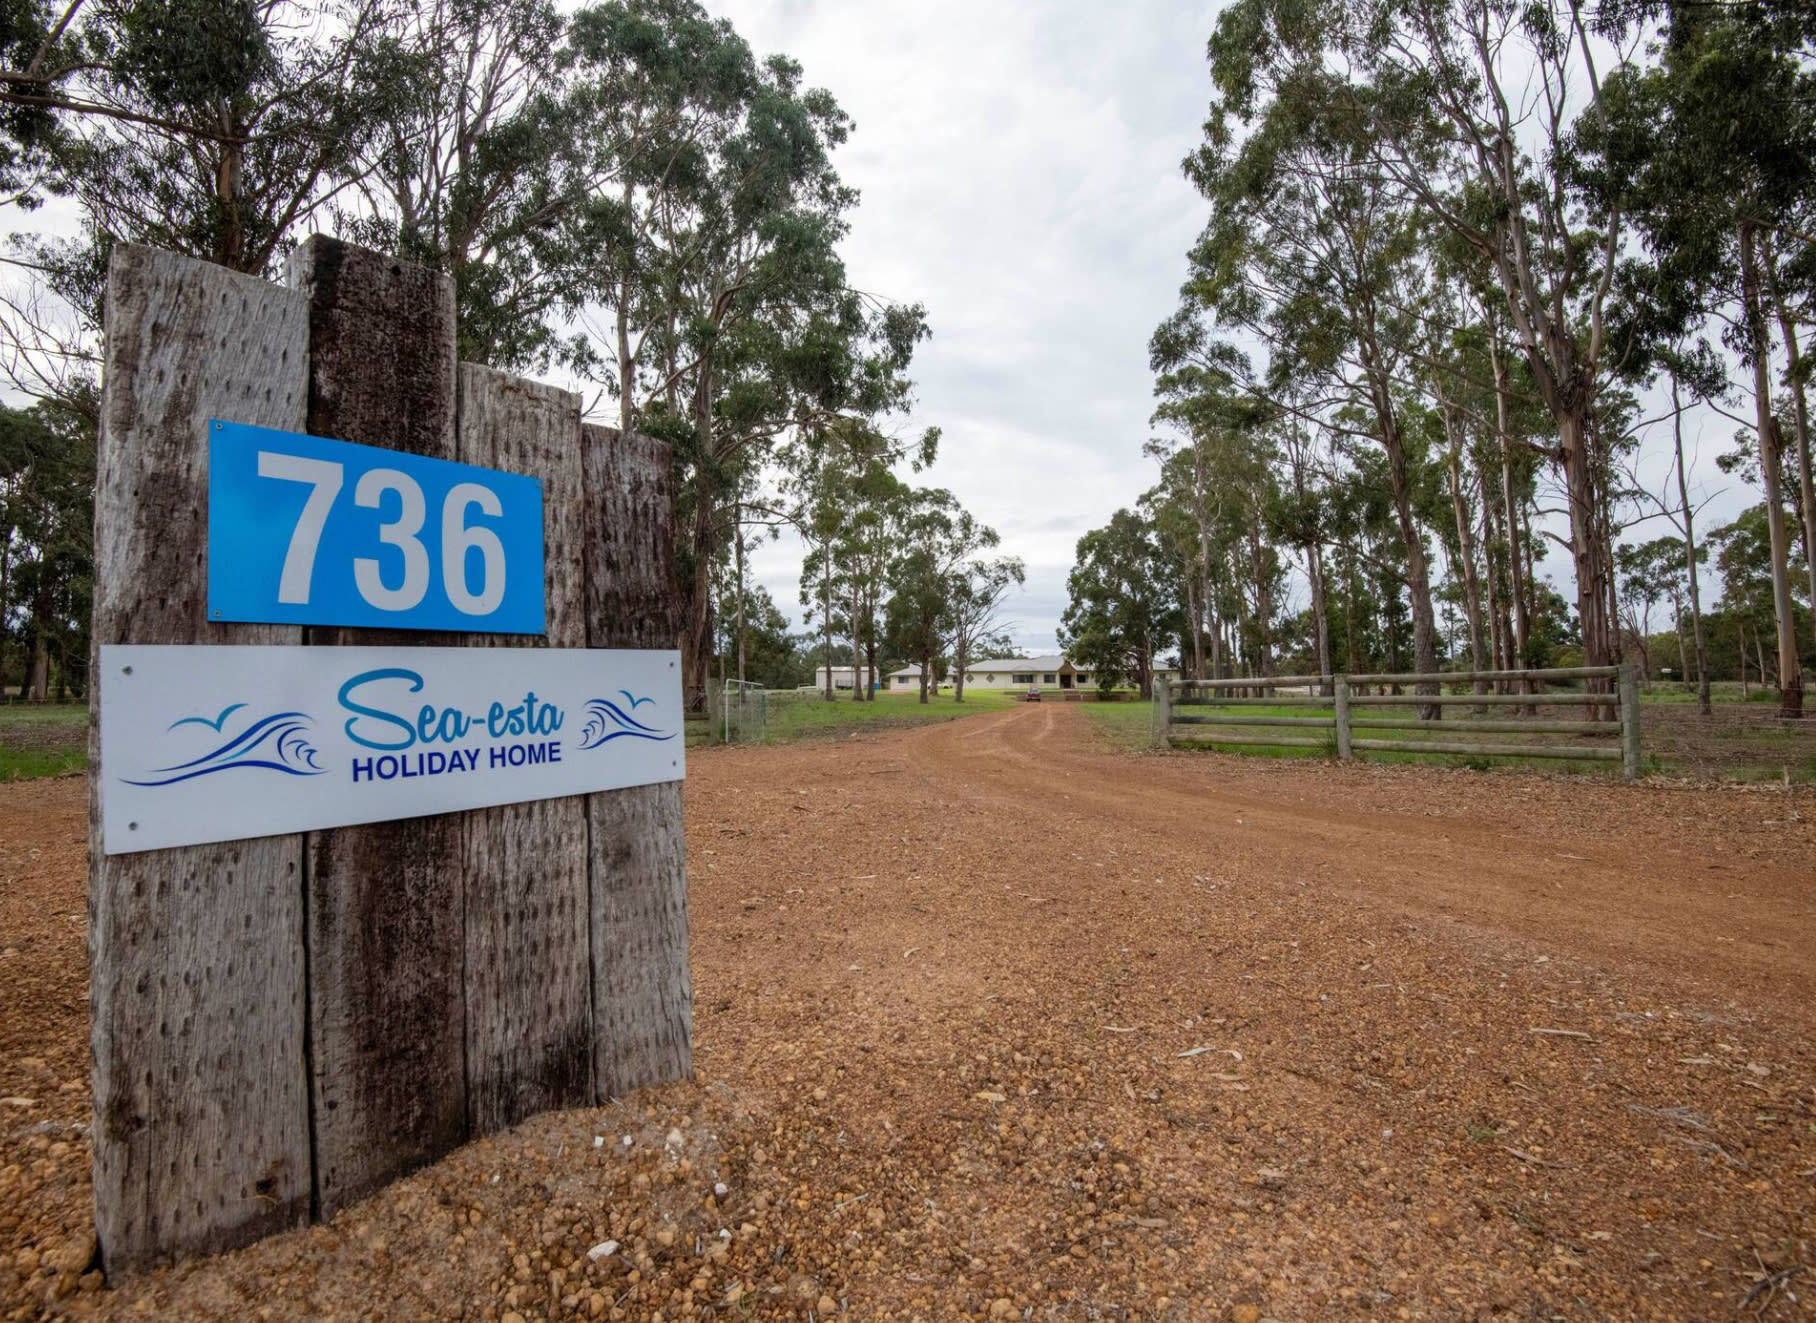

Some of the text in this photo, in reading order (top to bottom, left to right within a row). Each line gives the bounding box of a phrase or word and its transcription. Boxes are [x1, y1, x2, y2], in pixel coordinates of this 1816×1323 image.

[257, 450, 507, 616] 736
[337, 667, 565, 751] Sea-esta
[352, 741, 562, 782] HOLIDAY HOME
